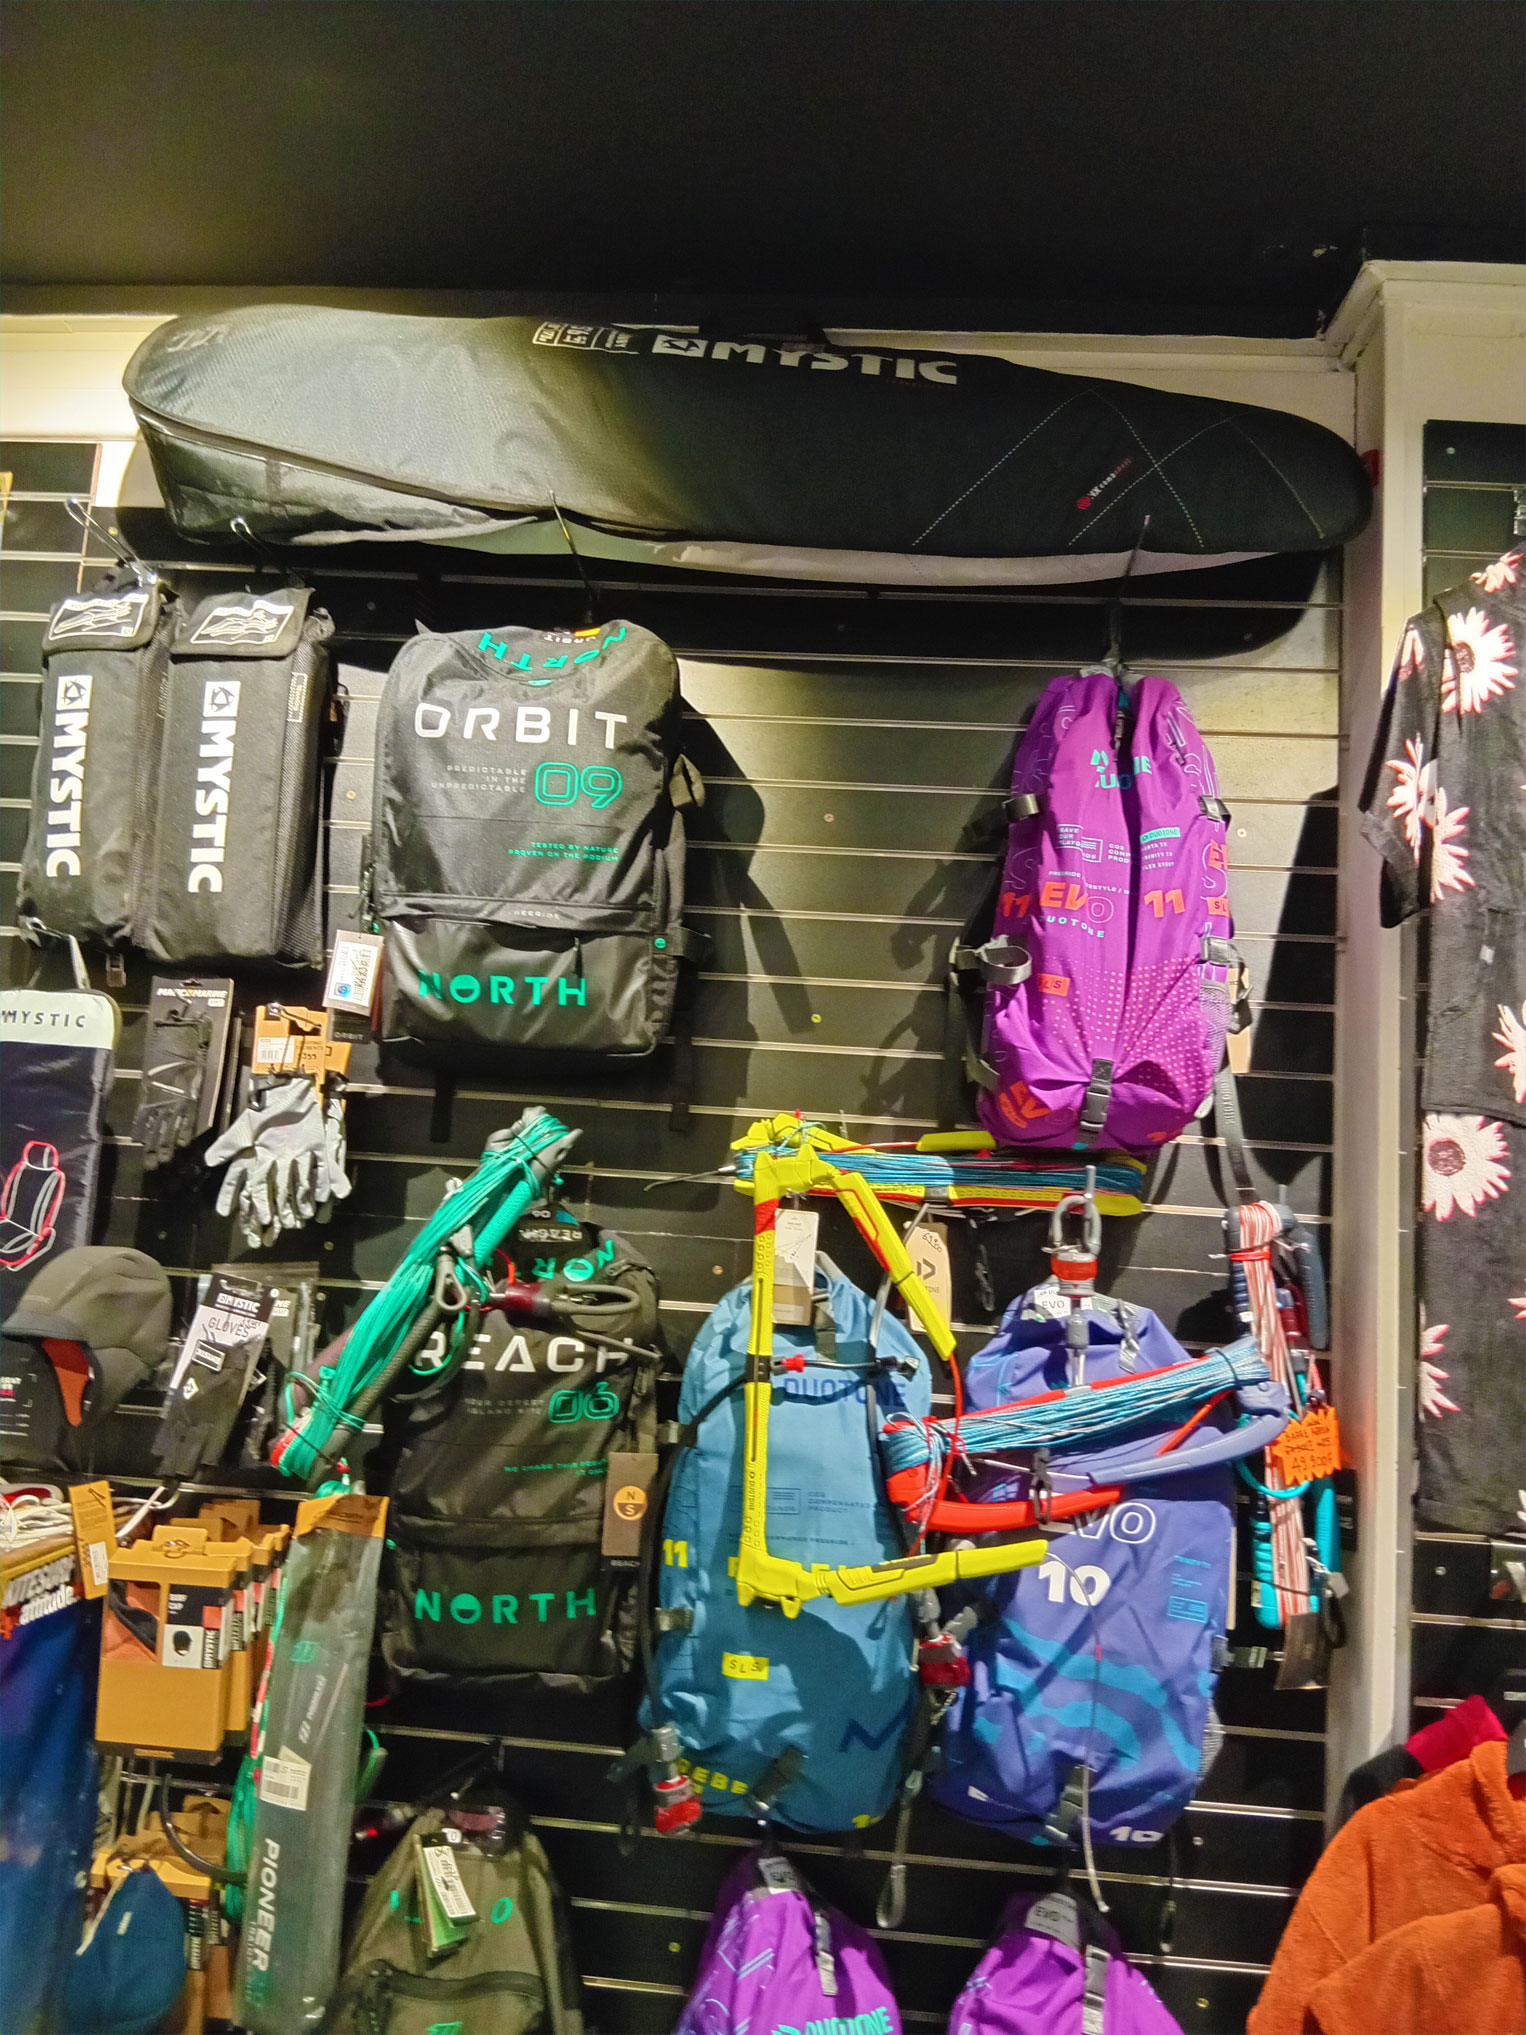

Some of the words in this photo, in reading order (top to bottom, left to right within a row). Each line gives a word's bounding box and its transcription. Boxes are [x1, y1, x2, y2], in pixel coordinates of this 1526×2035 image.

[710, 341, 958, 385] MYSTIC
[414, 702, 628, 750] ORBIT
[45, 712, 89, 877] MYSTIC
[504, 775, 526, 784] THE
[534, 762, 623, 809] 09
[187, 720, 237, 893] MYSTIC
[1002, 892, 1031, 918] 11
[1039, 881, 1114, 924] EVO
[1143, 889, 1185, 918] 11
[1046, 915, 1105, 938] UOTONE
[418, 969, 586, 1007] NORTH
[1, 1010, 86, 1028] MYSTIC
[1041, 1299, 1065, 1310] EVO
[207, 1316, 250, 1338] GLOVES
[547, 1382, 620, 1424] 06
[662, 1538, 689, 1568] 11
[1038, 1560, 1112, 1606] 10
[414, 1588, 597, 1624] NORTH
[1109, 1826, 1163, 1842] 10
[251, 1838, 281, 1972] PIONEER
